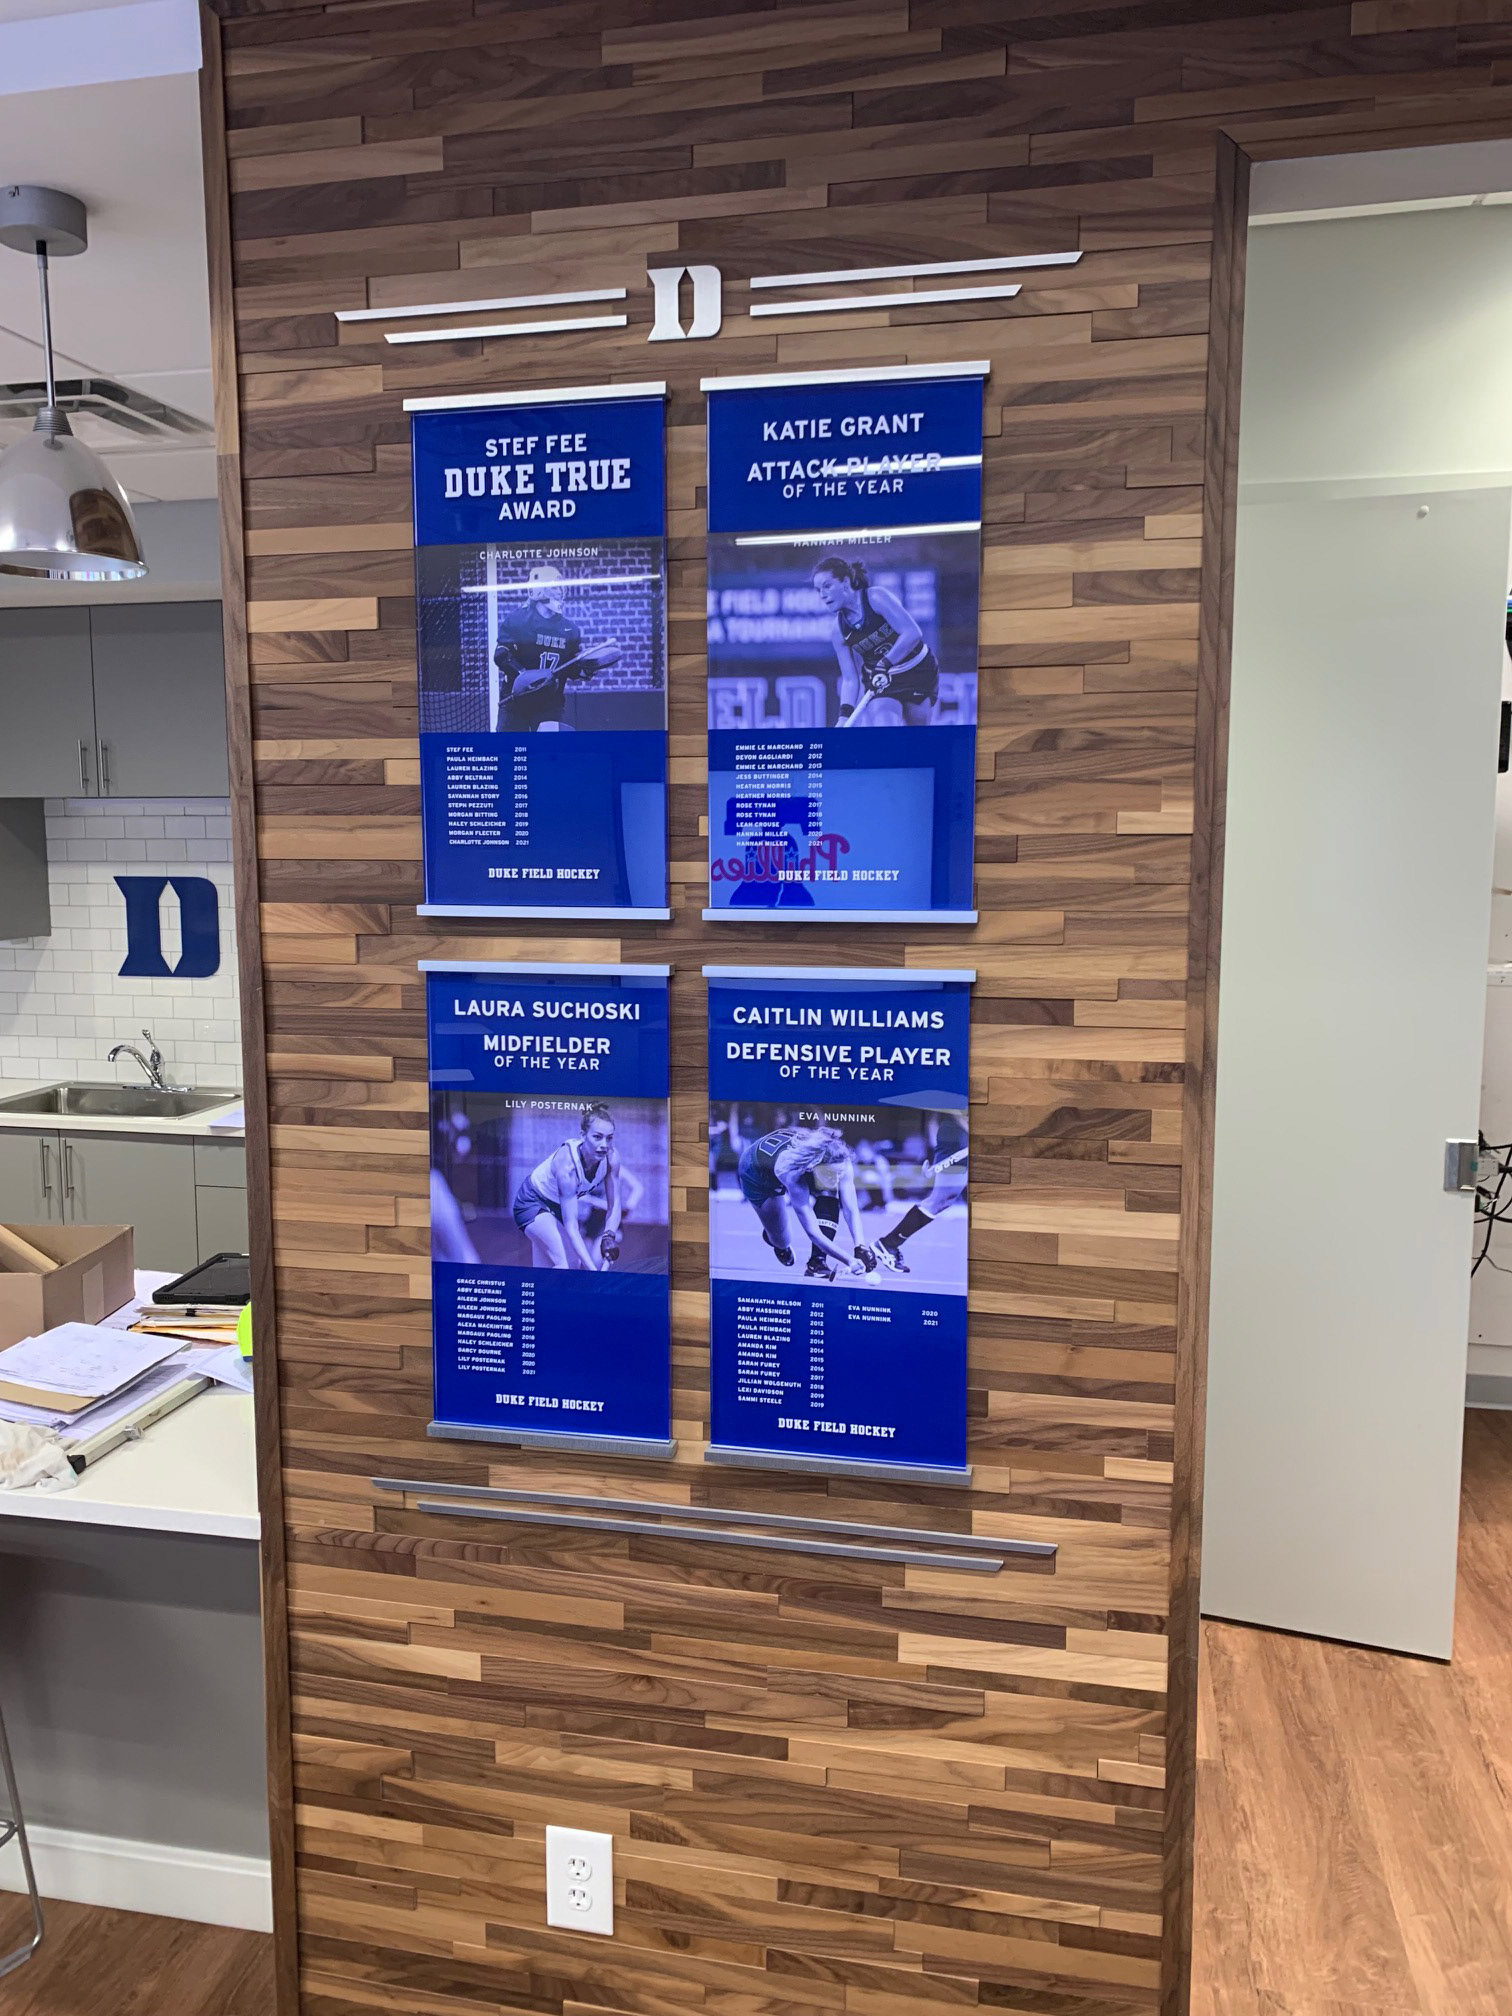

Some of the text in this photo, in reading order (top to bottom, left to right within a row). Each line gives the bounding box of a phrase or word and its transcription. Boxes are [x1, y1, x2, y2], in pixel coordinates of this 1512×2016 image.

[647, 264, 722, 341] D
[763, 412, 924, 441] KATIE GRANT
[485, 434, 587, 457] STEF FEE
[747, 453, 942, 482] ATTACK PLAYER
[445, 458, 631, 498] DUKE TRUE
[783, 479, 904, 499] OF THE YEAR
[498, 500, 576, 520] AWARD
[848, 534, 891, 545] MILLER
[480, 548, 598, 560] CHARLOTTE JOHNSON
[536, 634, 566, 649] DUKE
[488, 868, 600, 879] DUKE FIELD HOCKEY
[778, 871, 899, 881] DUKE FIELD HOCKEY
[113, 876, 220, 977] D
[454, 999, 640, 1020] LAURA SUCHOSKI
[732, 1006, 944, 1029] CAITLIN WILLIAMS
[483, 1034, 610, 1054] MIDFIELDER
[726, 1042, 951, 1066] DEFENSIVE PLAYER
[494, 1055, 600, 1071] OF THE YEAR
[779, 1065, 895, 1082] OF THE YEAR
[505, 1100, 592, 1111] LILY POSTERNAK
[799, 1112, 875, 1122] EVA NUNNINK
[496, 1394, 604, 1411] DUKE FIELD HOCKEY
[778, 1418, 895, 1438] DUKE FIELD HOCKEY
